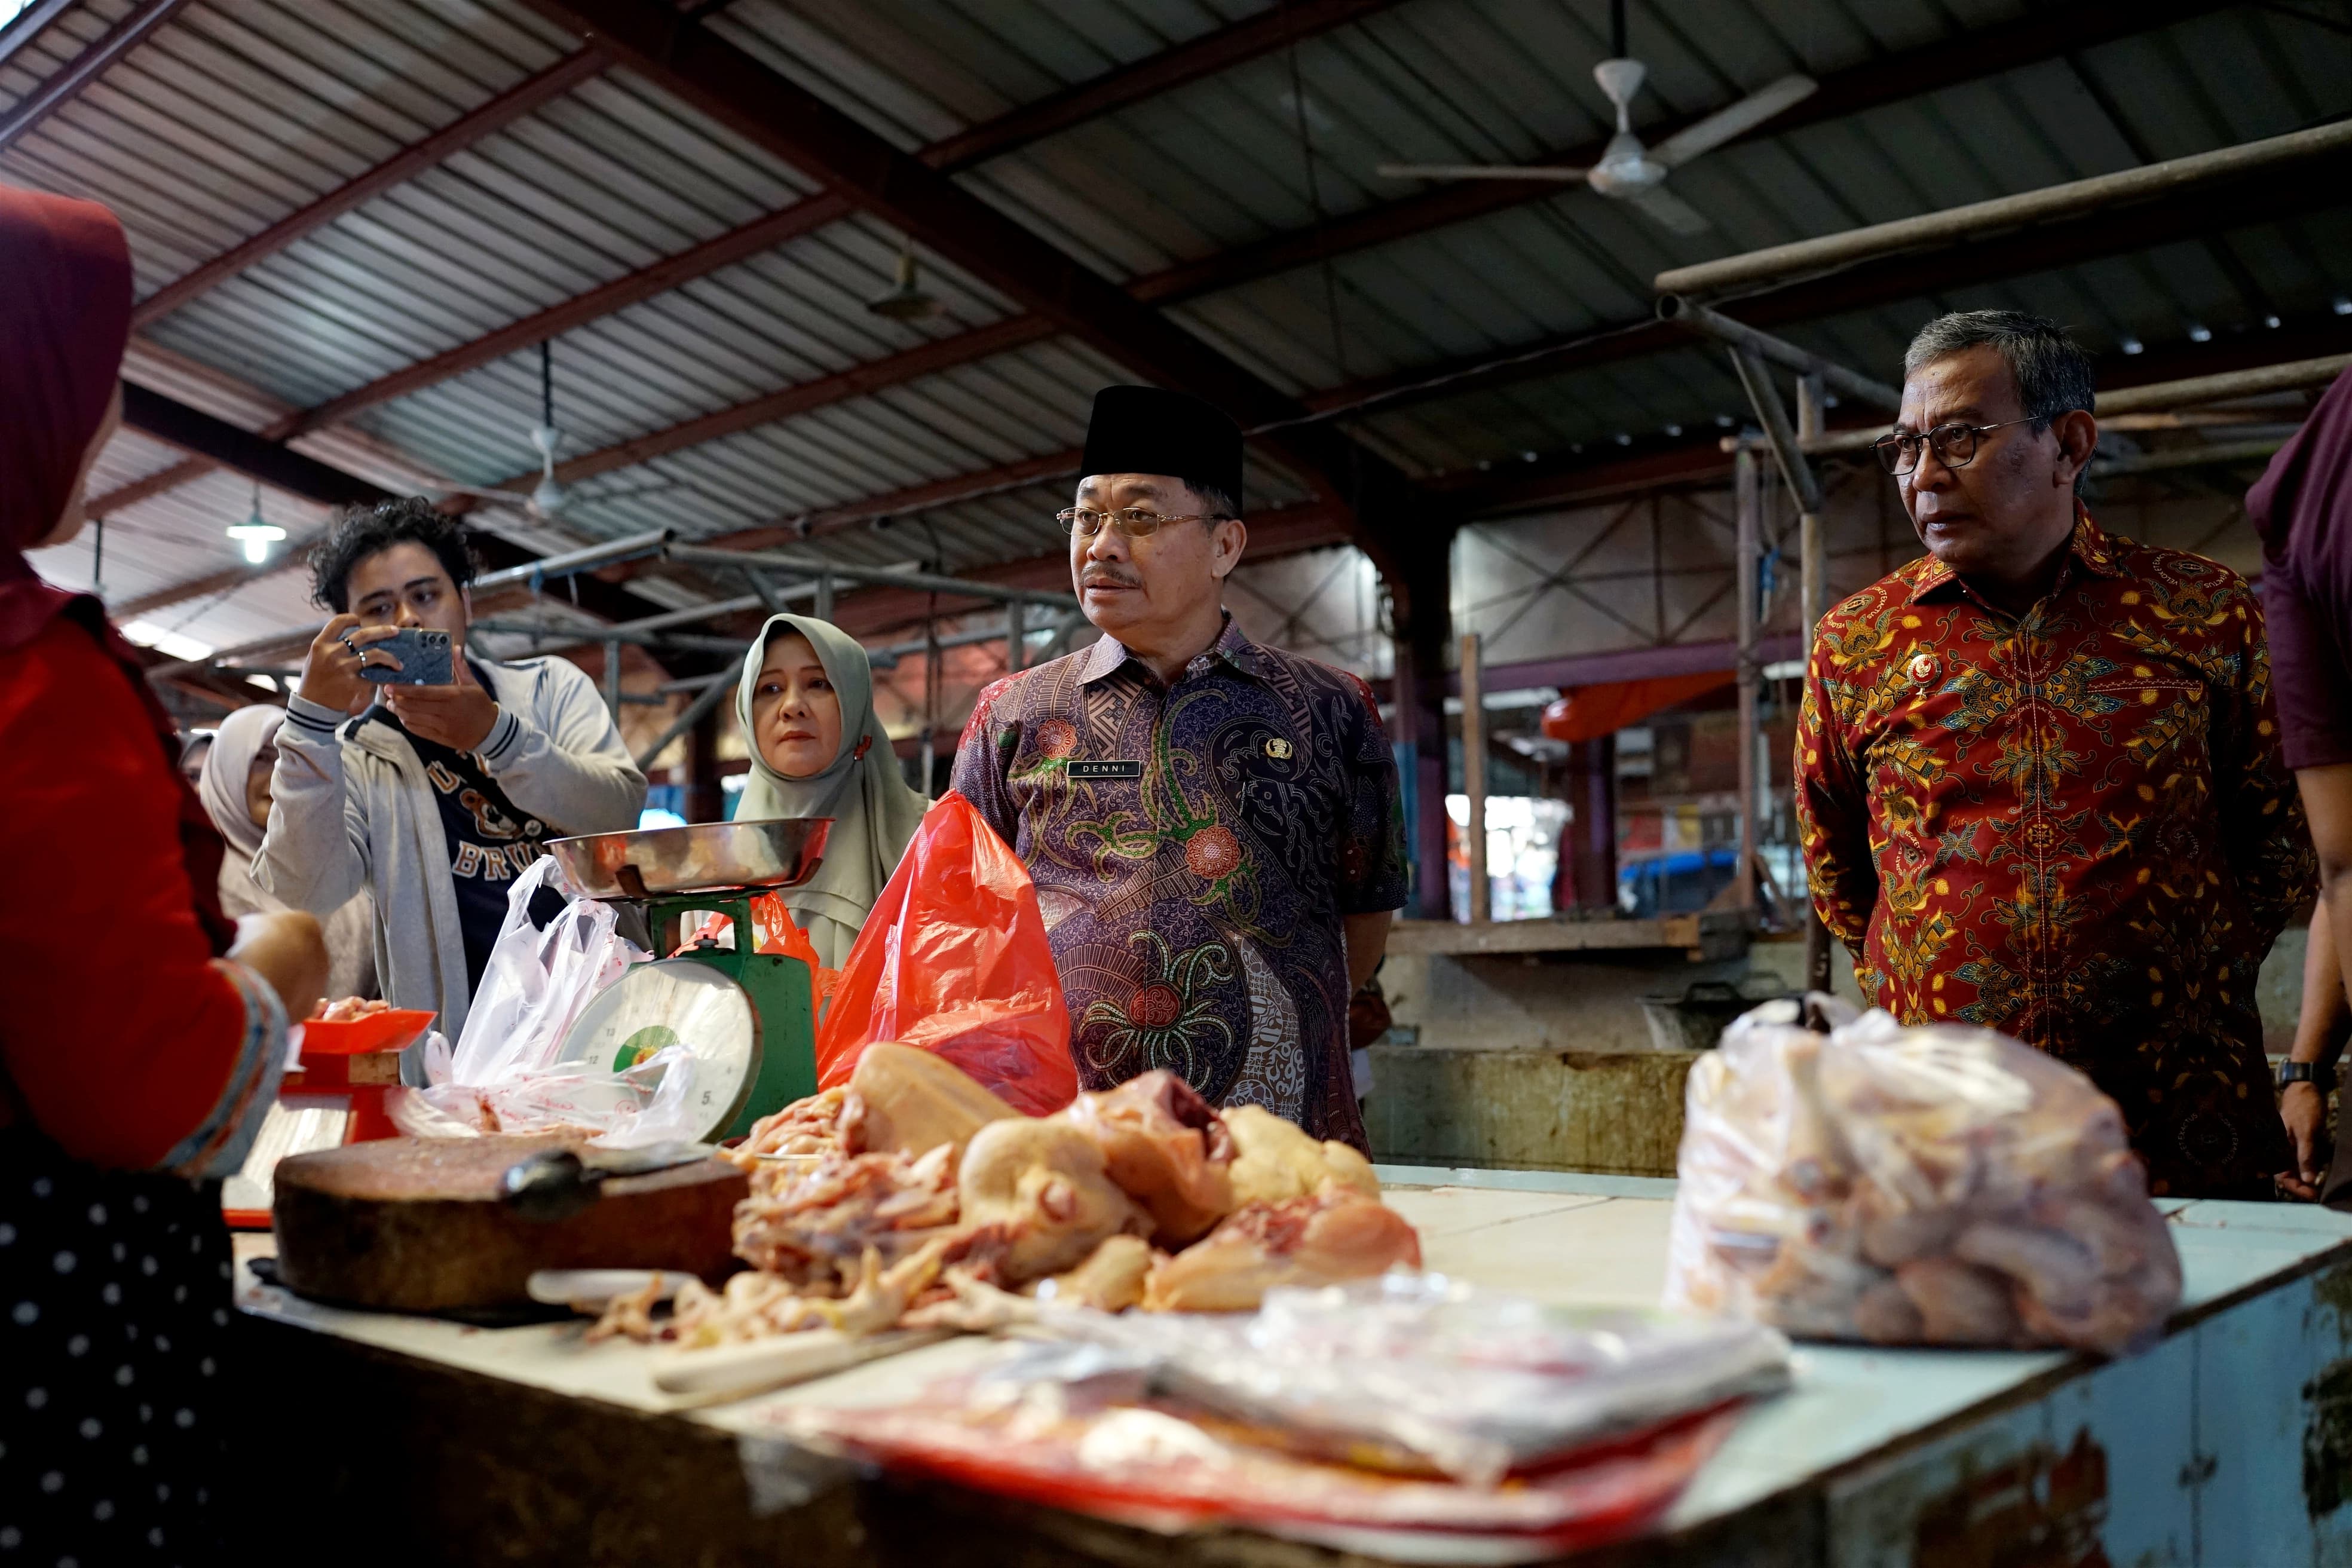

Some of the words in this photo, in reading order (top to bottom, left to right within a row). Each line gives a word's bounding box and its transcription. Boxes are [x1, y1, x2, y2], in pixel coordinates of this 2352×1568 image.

[452, 840, 545, 881] BRU
[606, 1028, 615, 1037] 13
[589, 1055, 598, 1064] 12
[701, 1091, 712, 1105] 5
